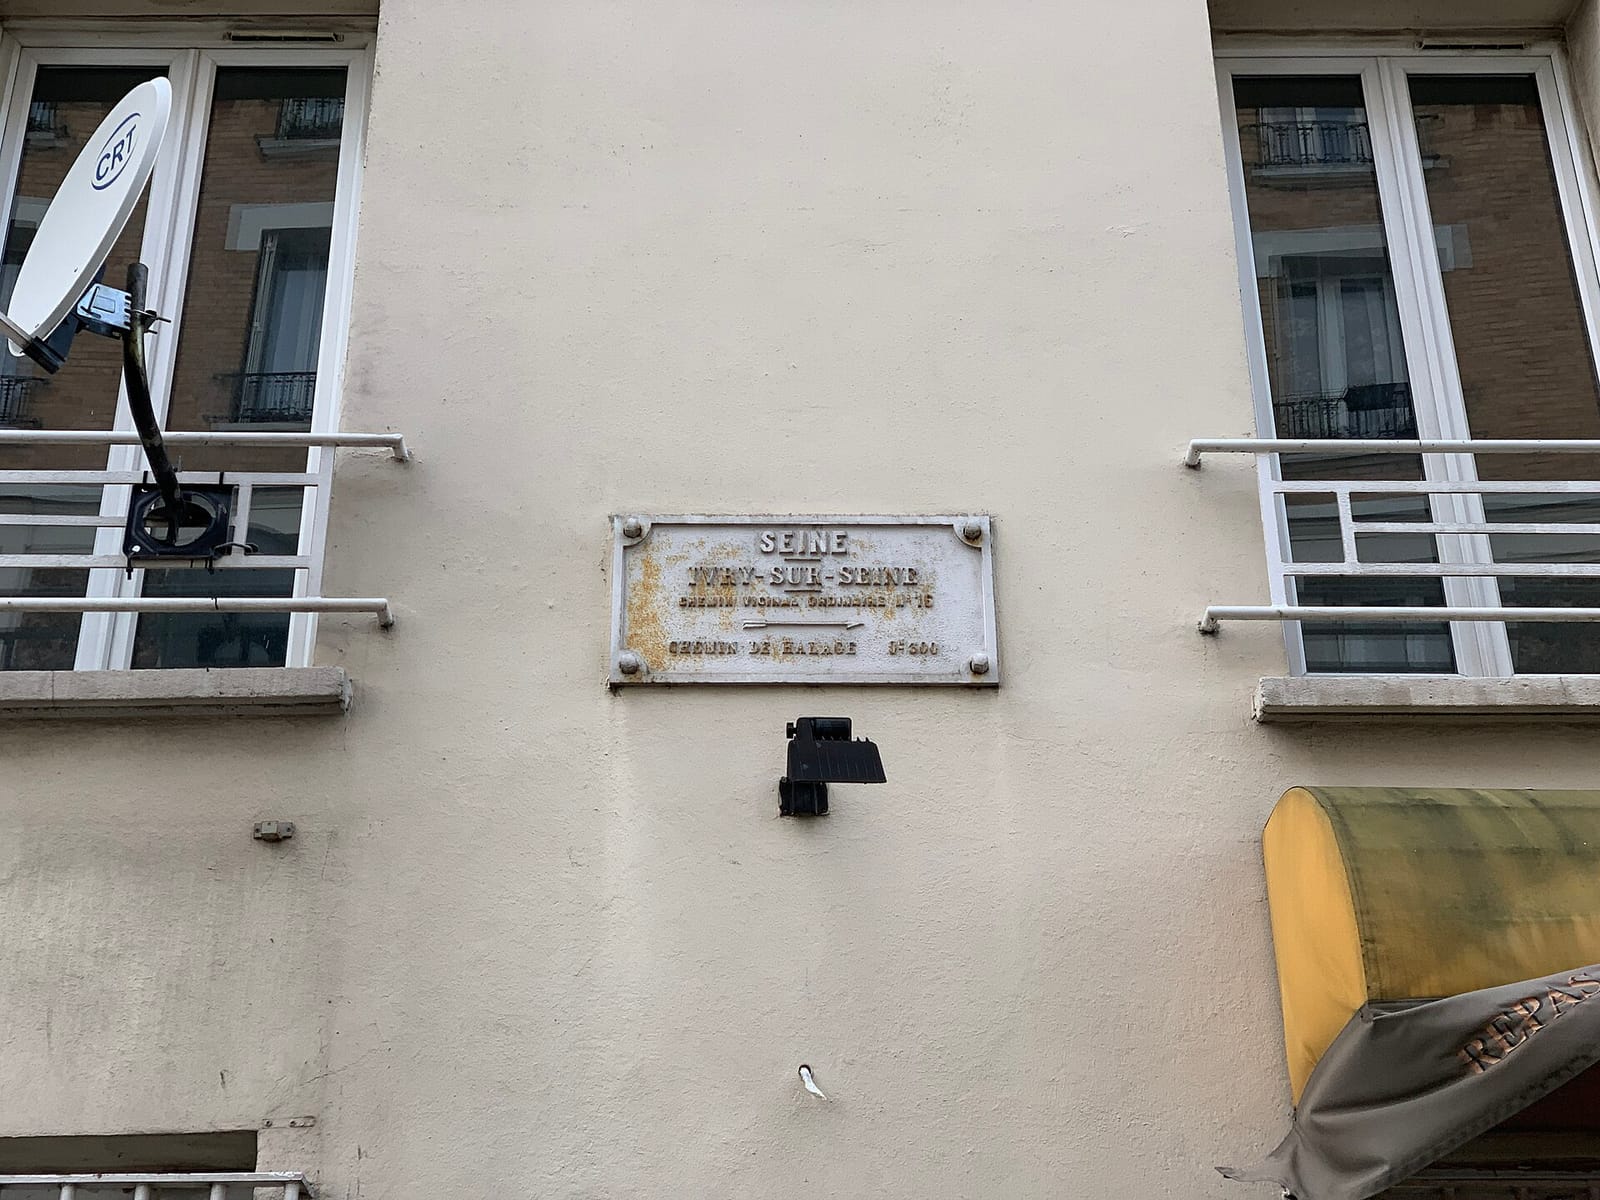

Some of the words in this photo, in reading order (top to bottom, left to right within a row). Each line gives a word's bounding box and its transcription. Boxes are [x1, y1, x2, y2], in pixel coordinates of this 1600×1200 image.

[95, 123, 137, 181] CRT
[760, 530, 849, 556] SEINE
[687, 566, 919, 587] IVRY-SUR-SEINE
[668, 640, 738, 655] CHEMIN
[748, 640, 771, 655] DE
[1456, 972, 1600, 1075] REPAS
